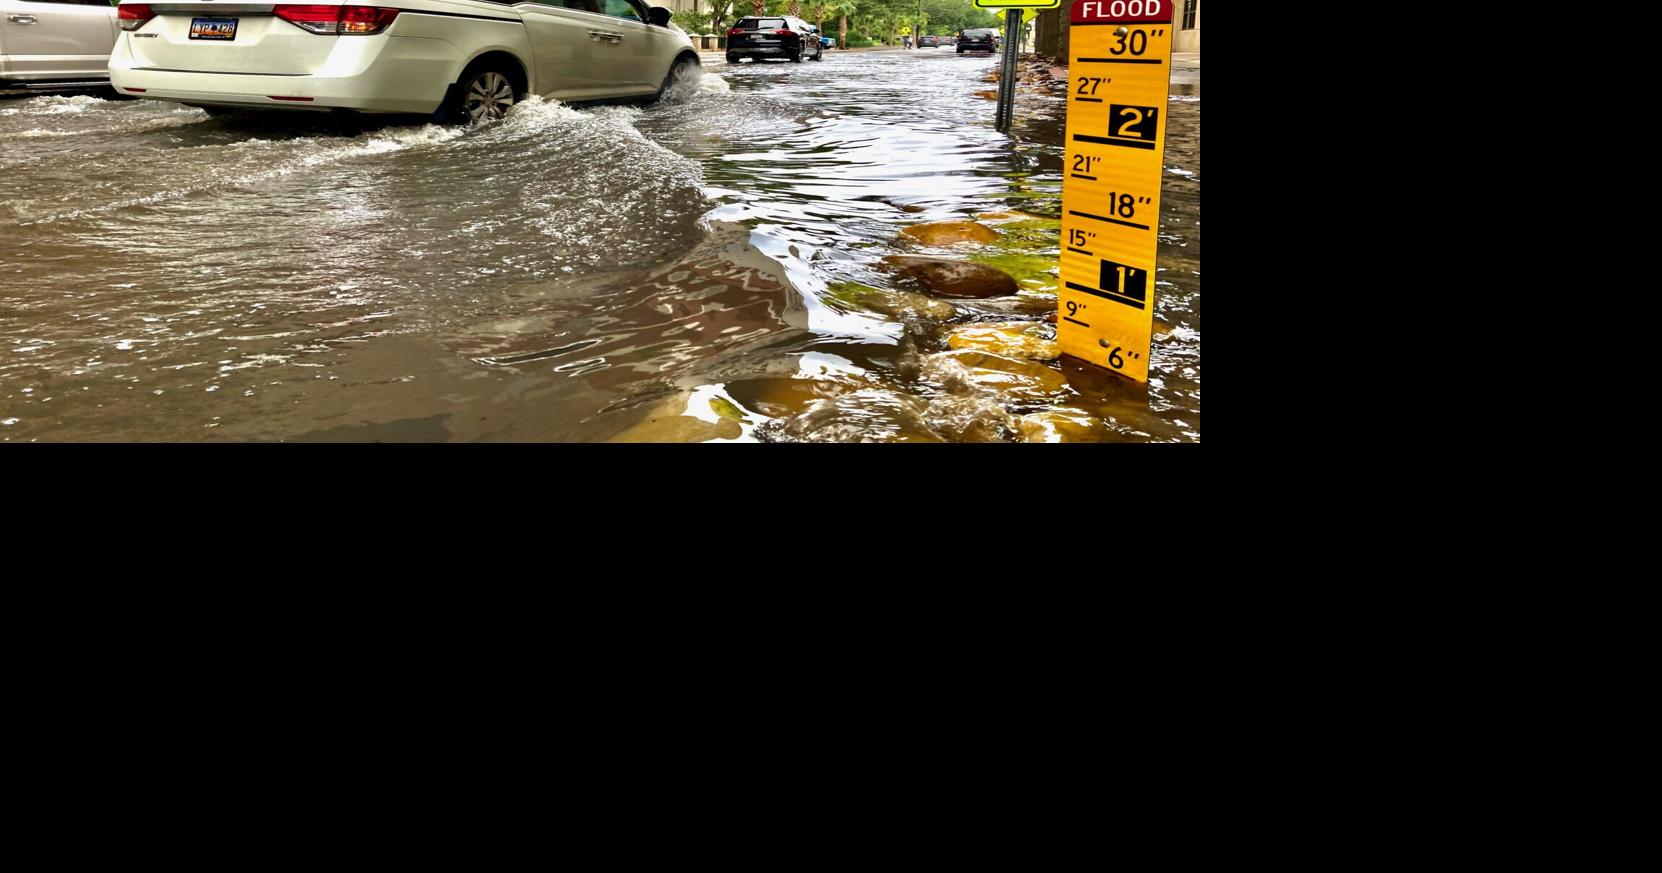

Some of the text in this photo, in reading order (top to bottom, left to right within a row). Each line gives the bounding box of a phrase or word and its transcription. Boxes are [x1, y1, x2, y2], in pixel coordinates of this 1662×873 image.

[1083, 0, 1161, 17] FLOOD
[1109, 29, 1164, 56] 30"
[1077, 77, 1111, 95] 27"
[1118, 107, 1154, 138] 2'
[1072, 154, 1101, 173] 21"
[1109, 192, 1151, 219] 18"
[1069, 228, 1096, 247] 15"
[1116, 266, 1135, 294] 1'
[1066, 301, 1087, 317] 9"
[1108, 346, 1140, 369] 6"
